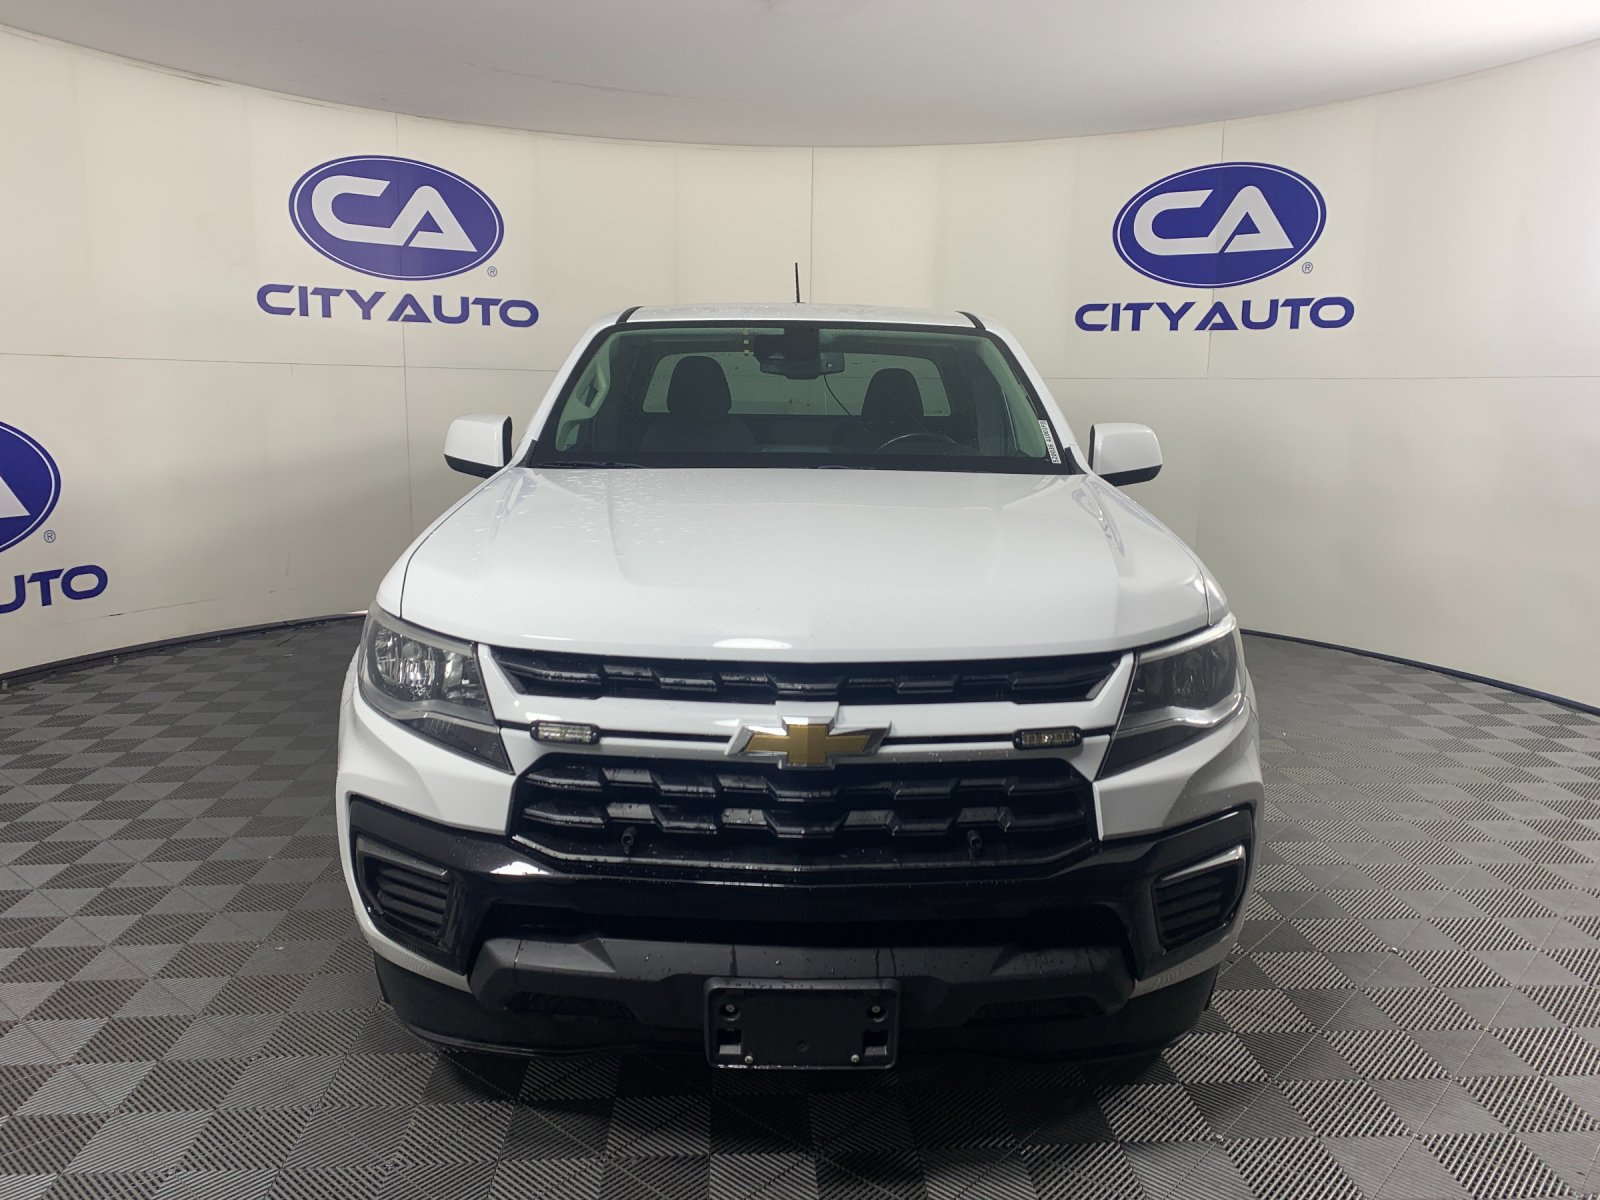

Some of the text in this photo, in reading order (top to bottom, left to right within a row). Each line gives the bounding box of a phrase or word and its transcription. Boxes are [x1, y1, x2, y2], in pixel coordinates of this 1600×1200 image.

[311, 174, 478, 252] CA
[1133, 185, 1295, 256] CA
[256, 283, 539, 328] CITY AUTO
[1075, 296, 1355, 332] CITY AUTO
[0, 564, 108, 614] UTO
